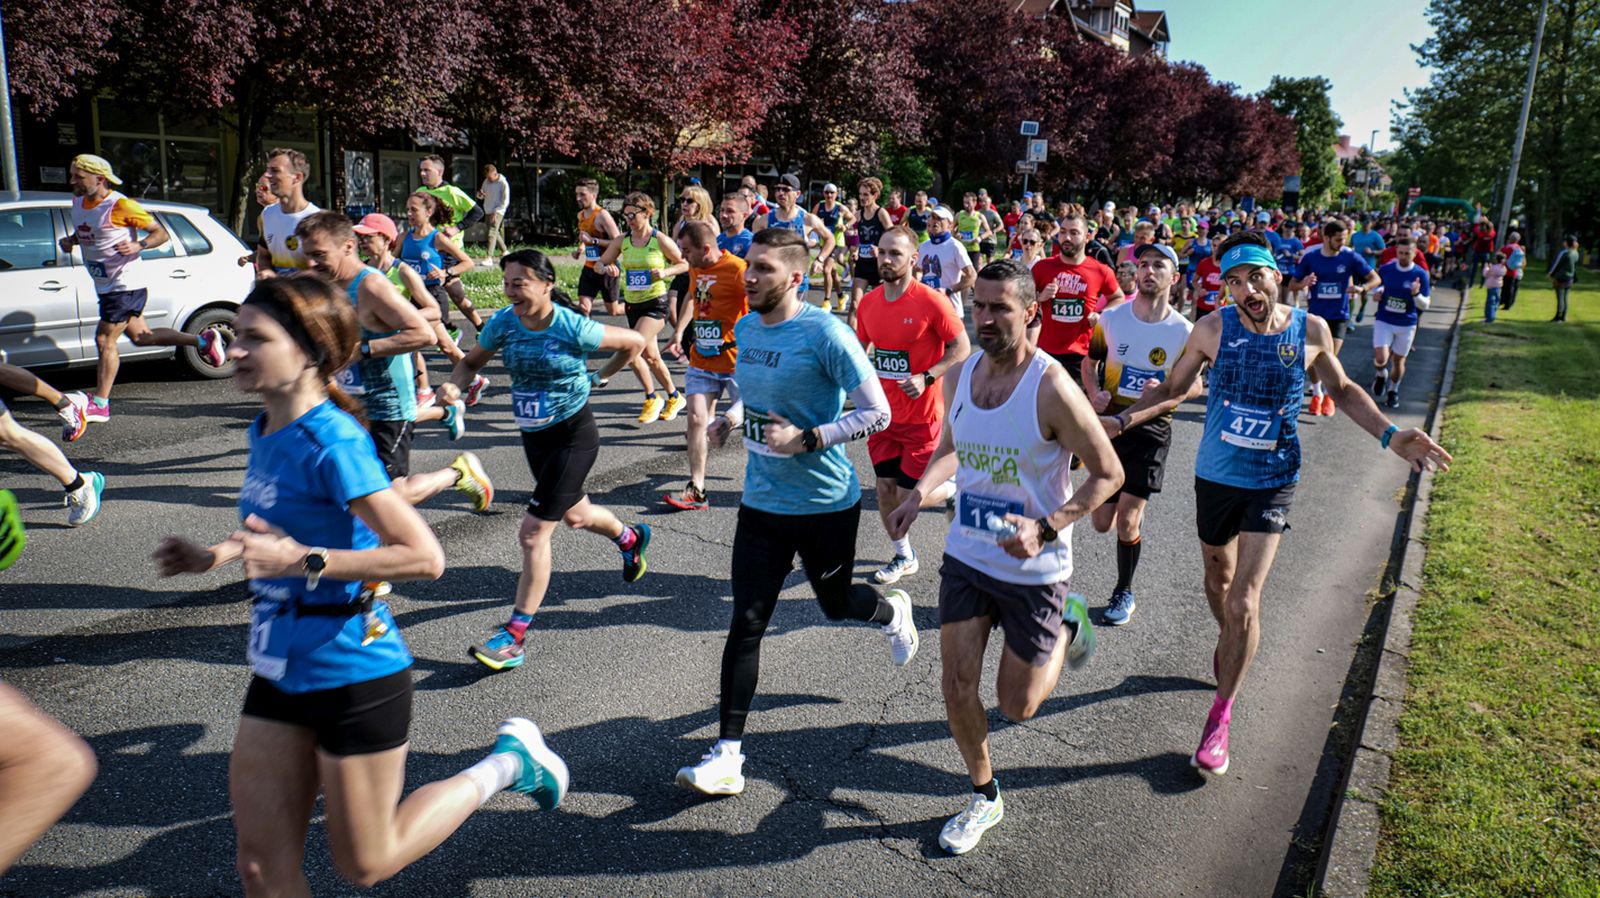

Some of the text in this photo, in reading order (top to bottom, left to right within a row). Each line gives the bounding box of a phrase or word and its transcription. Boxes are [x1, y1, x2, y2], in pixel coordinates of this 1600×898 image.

[629, 275, 647, 285] 369
[1322, 285, 1338, 294] 143
[1053, 304, 1083, 316] 1410
[694, 326, 720, 339] 1060
[875, 356, 909, 372] 1409
[517, 400, 541, 417] 147
[1230, 415, 1273, 438] 477
